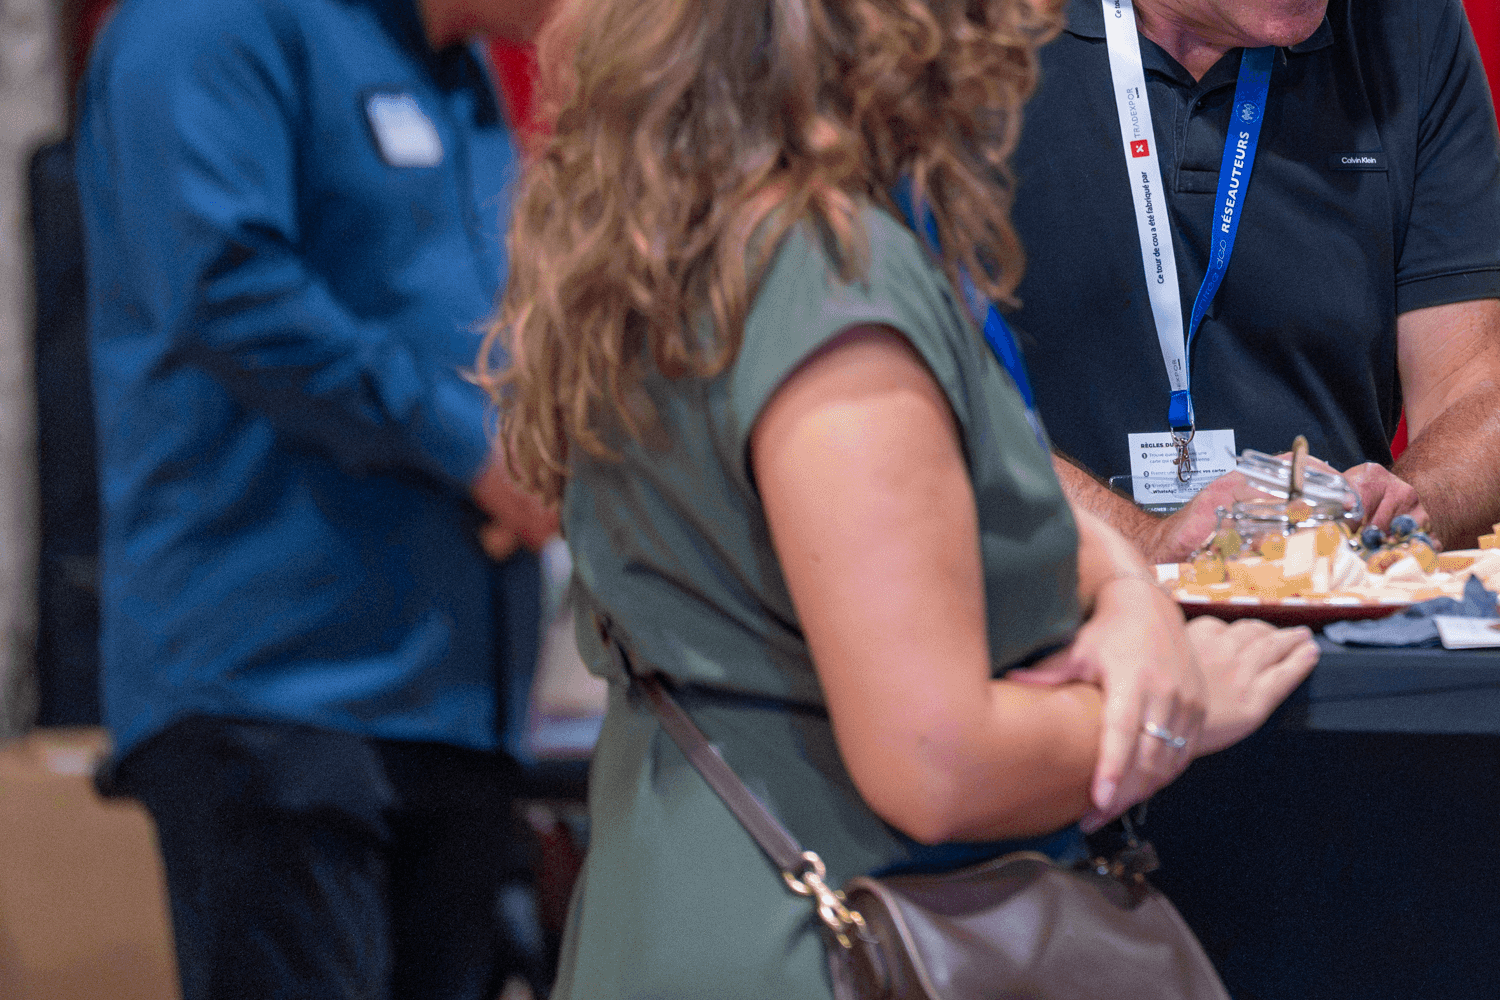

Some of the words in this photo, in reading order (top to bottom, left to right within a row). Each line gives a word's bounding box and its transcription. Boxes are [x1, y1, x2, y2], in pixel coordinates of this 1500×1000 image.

[1126, 87, 1141, 139] TRADEXPOR
[1141, 171, 1150, 183] par
[1221, 131, 1250, 234] RÉSEAUTEURS
[1142, 184, 1154, 214] fabriqué
[1147, 215, 1156, 226] été
[1151, 233, 1159, 247] cou
[1153, 247, 1161, 257] de
[1155, 258, 1163, 273] tour
[1157, 274, 1165, 284] Ce
